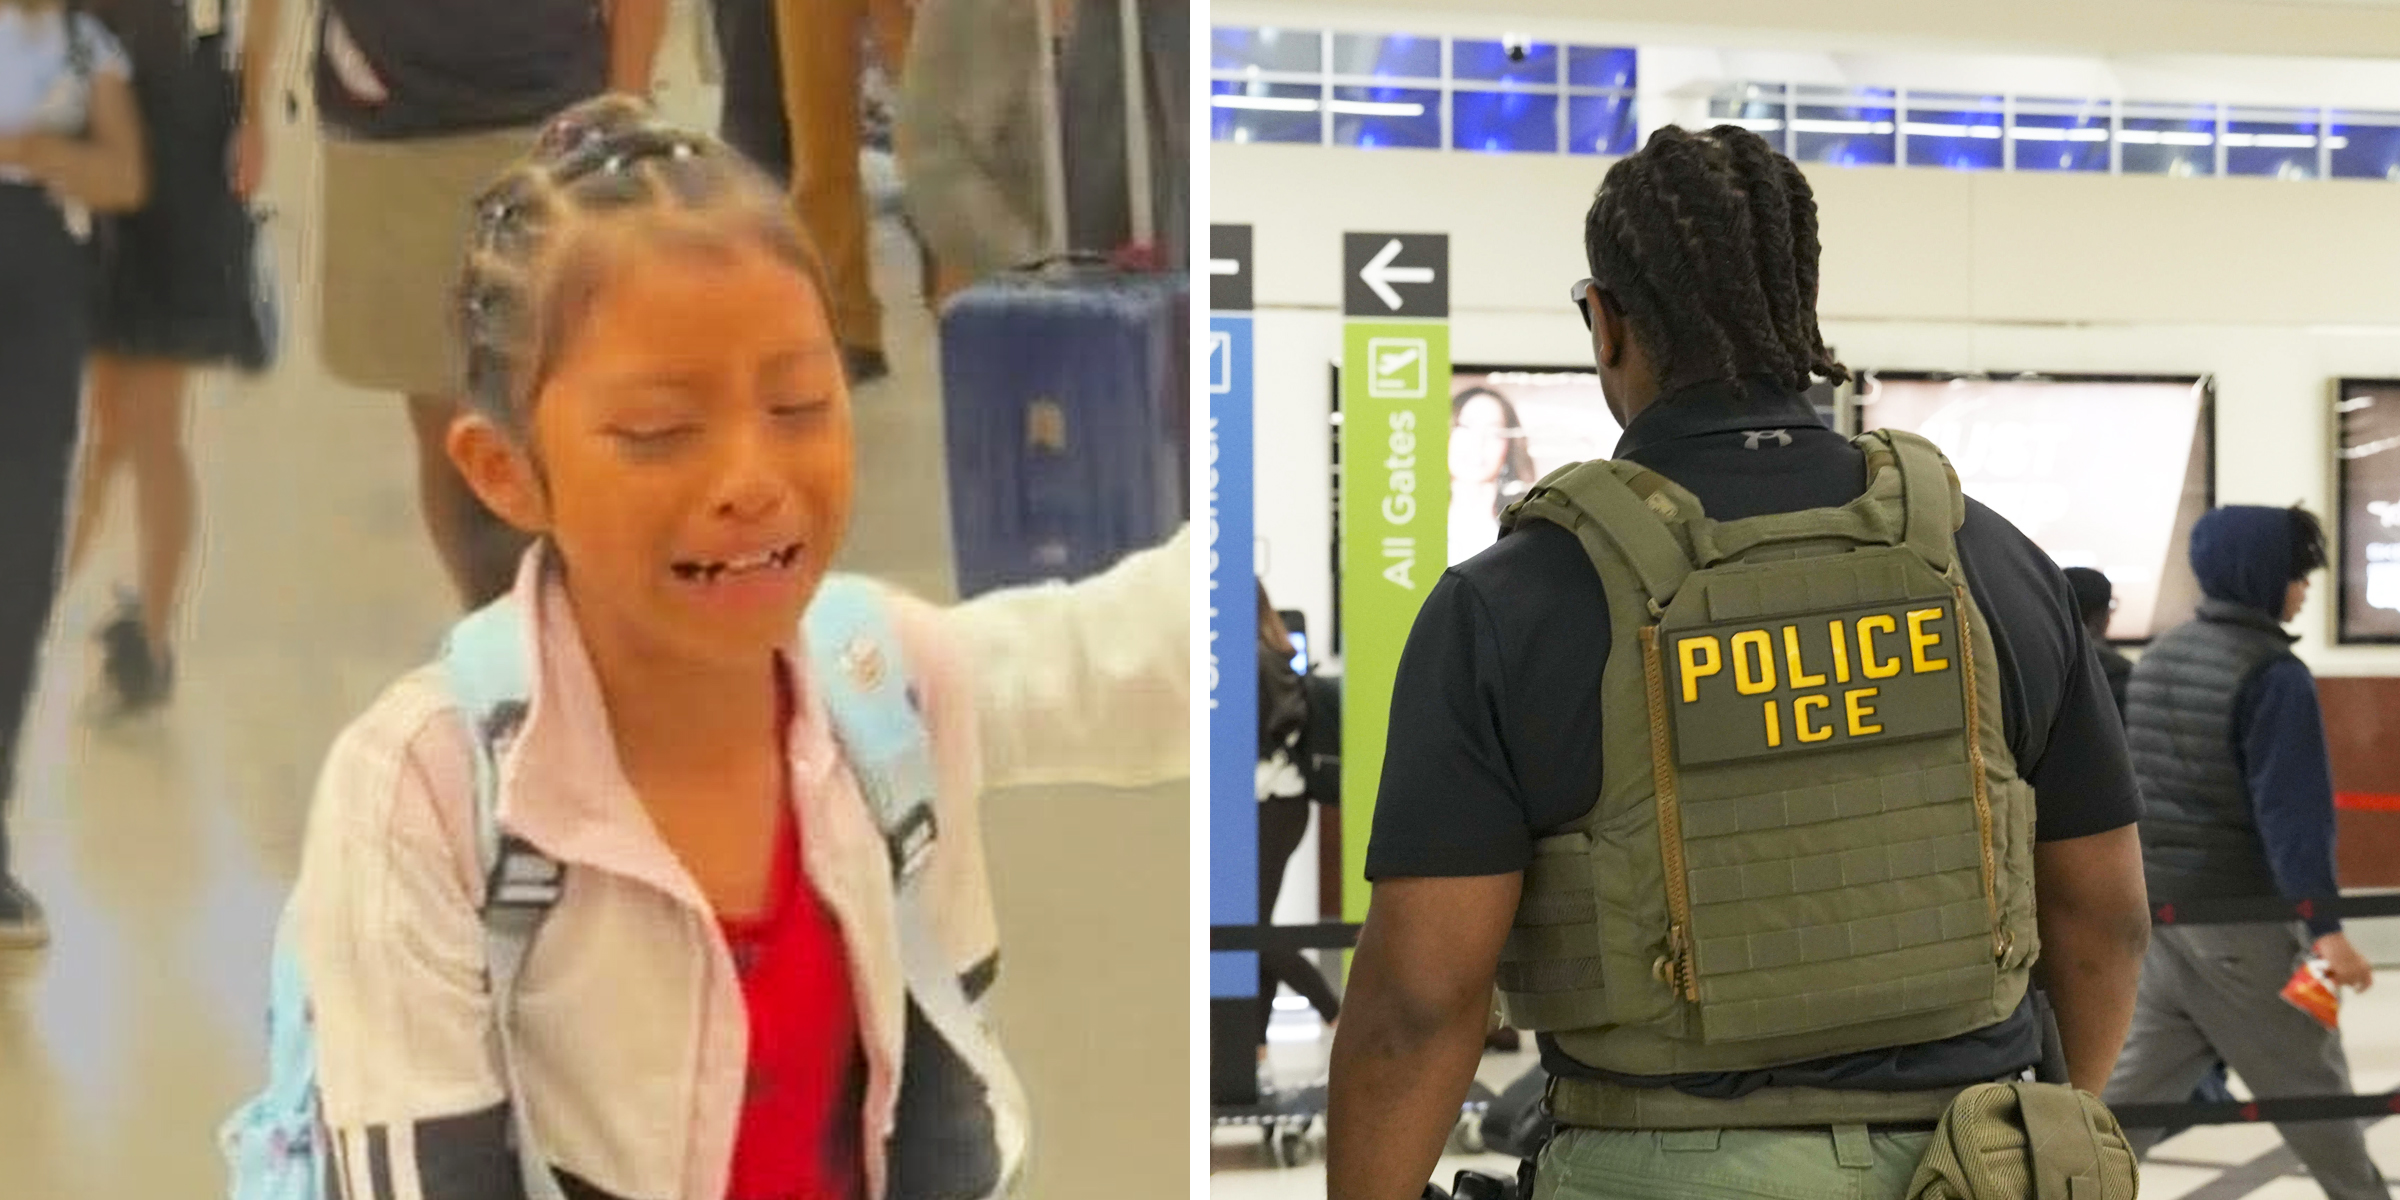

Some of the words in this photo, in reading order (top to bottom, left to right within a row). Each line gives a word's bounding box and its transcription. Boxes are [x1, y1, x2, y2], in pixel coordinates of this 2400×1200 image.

[1381, 409, 1416, 526] Gates
[1381, 536, 1416, 591] All
[1677, 606, 1950, 703] POLICE
[1763, 686, 1883, 748] ICE
